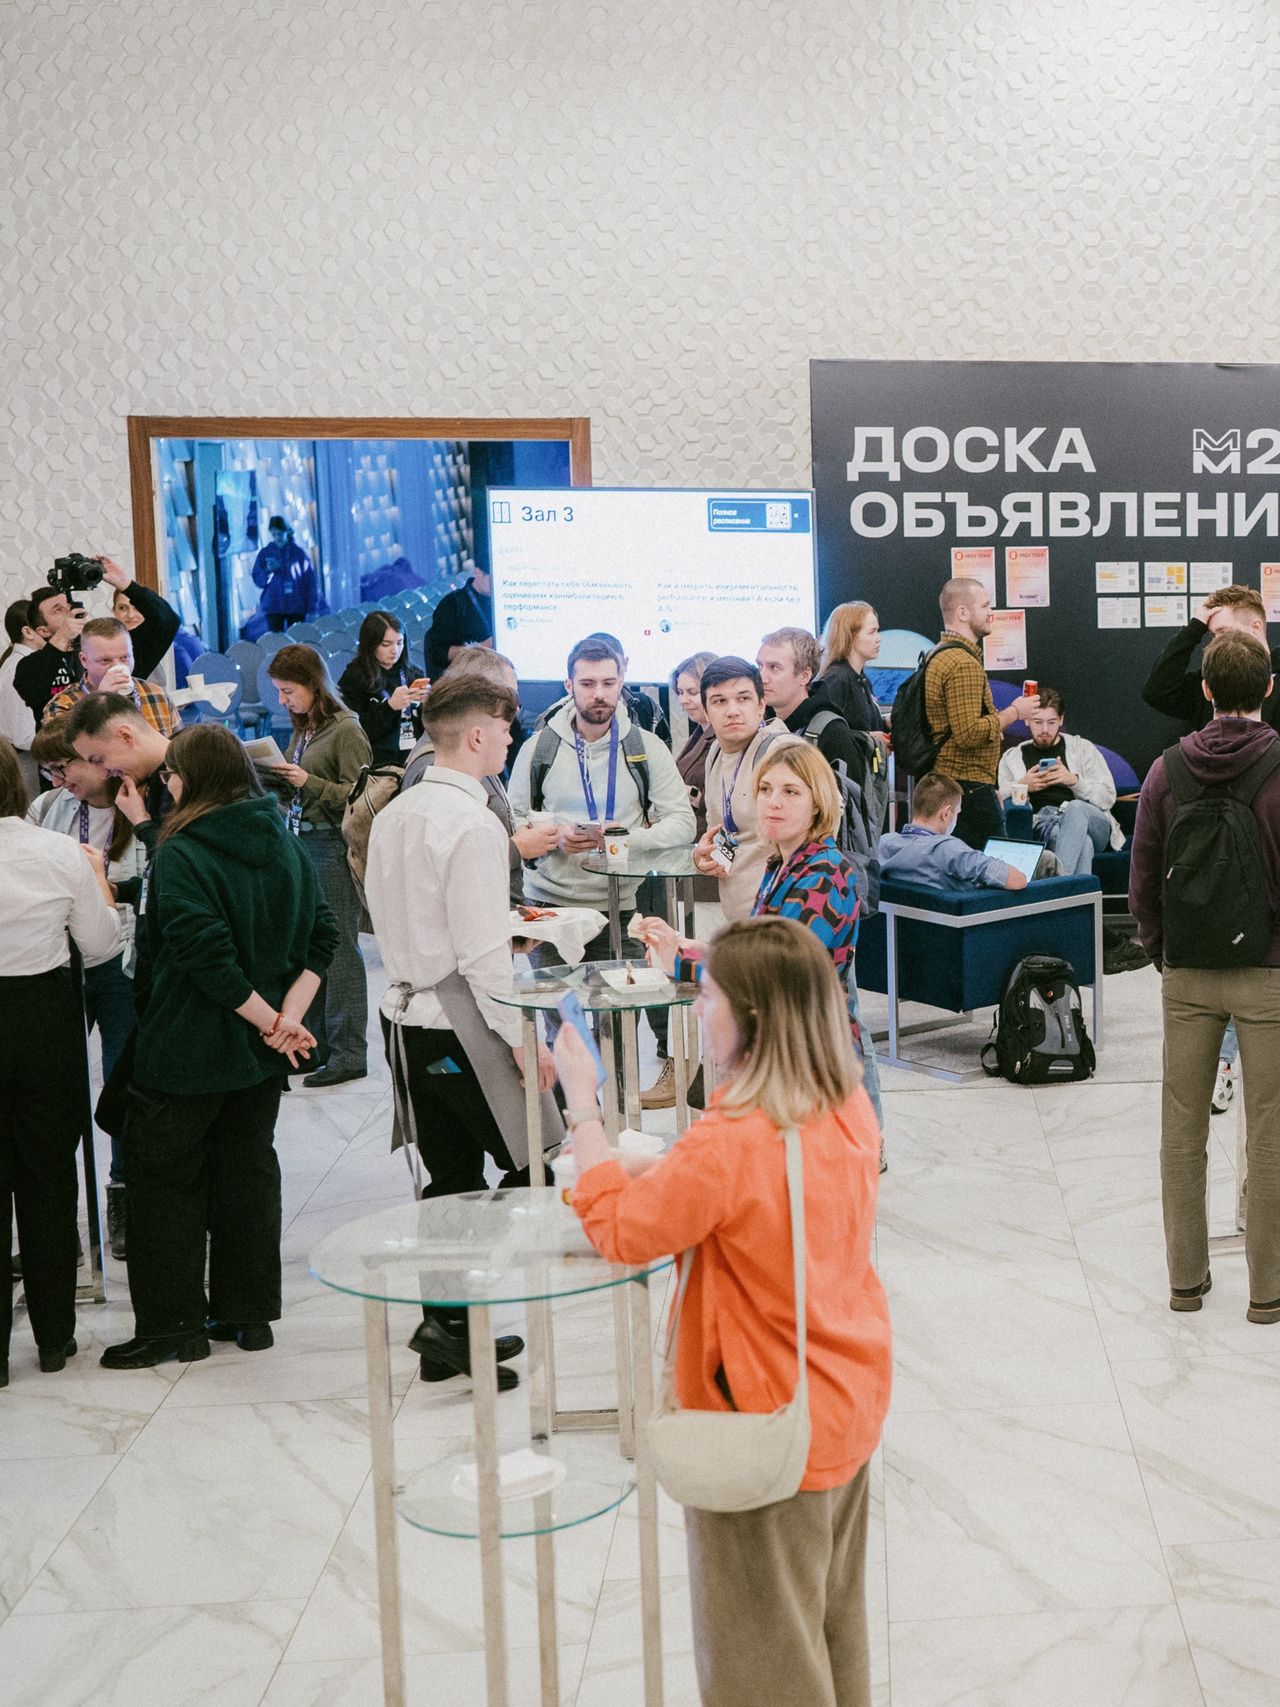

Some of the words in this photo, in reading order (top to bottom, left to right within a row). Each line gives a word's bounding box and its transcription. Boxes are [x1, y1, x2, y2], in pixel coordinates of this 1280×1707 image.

[846, 426, 1096, 482] ДОСКА
[522, 506, 556, 522] Зал
[563, 506, 574, 522] 3
